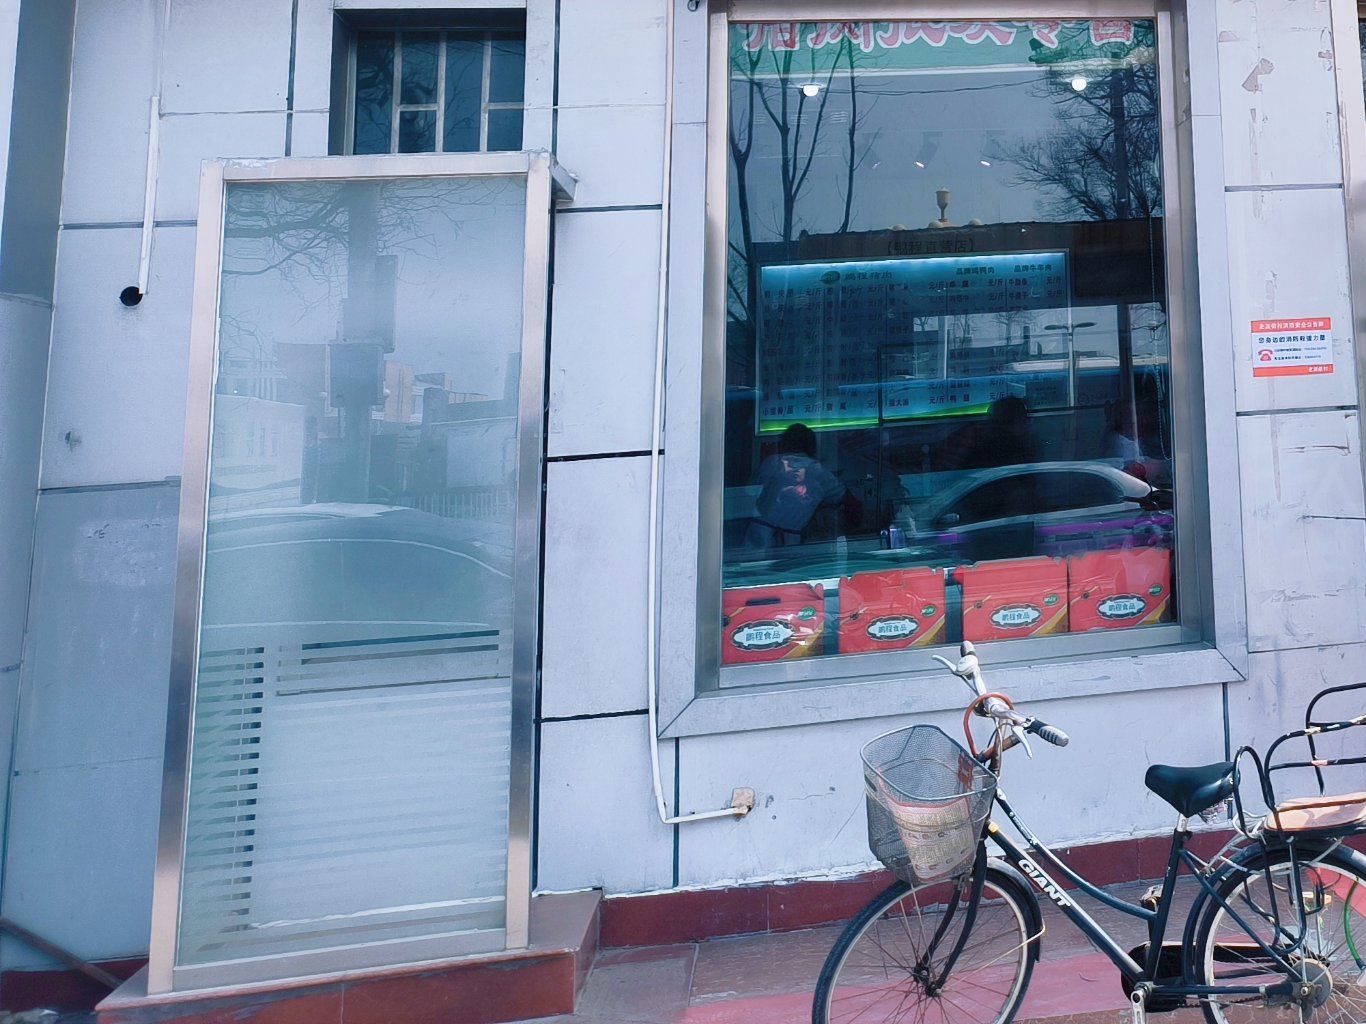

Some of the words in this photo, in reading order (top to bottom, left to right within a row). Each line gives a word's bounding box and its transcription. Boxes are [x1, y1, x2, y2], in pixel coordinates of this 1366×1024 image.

[745, 630, 781, 642] 鹏程食品
[1018, 859, 1072, 907] GIANT
